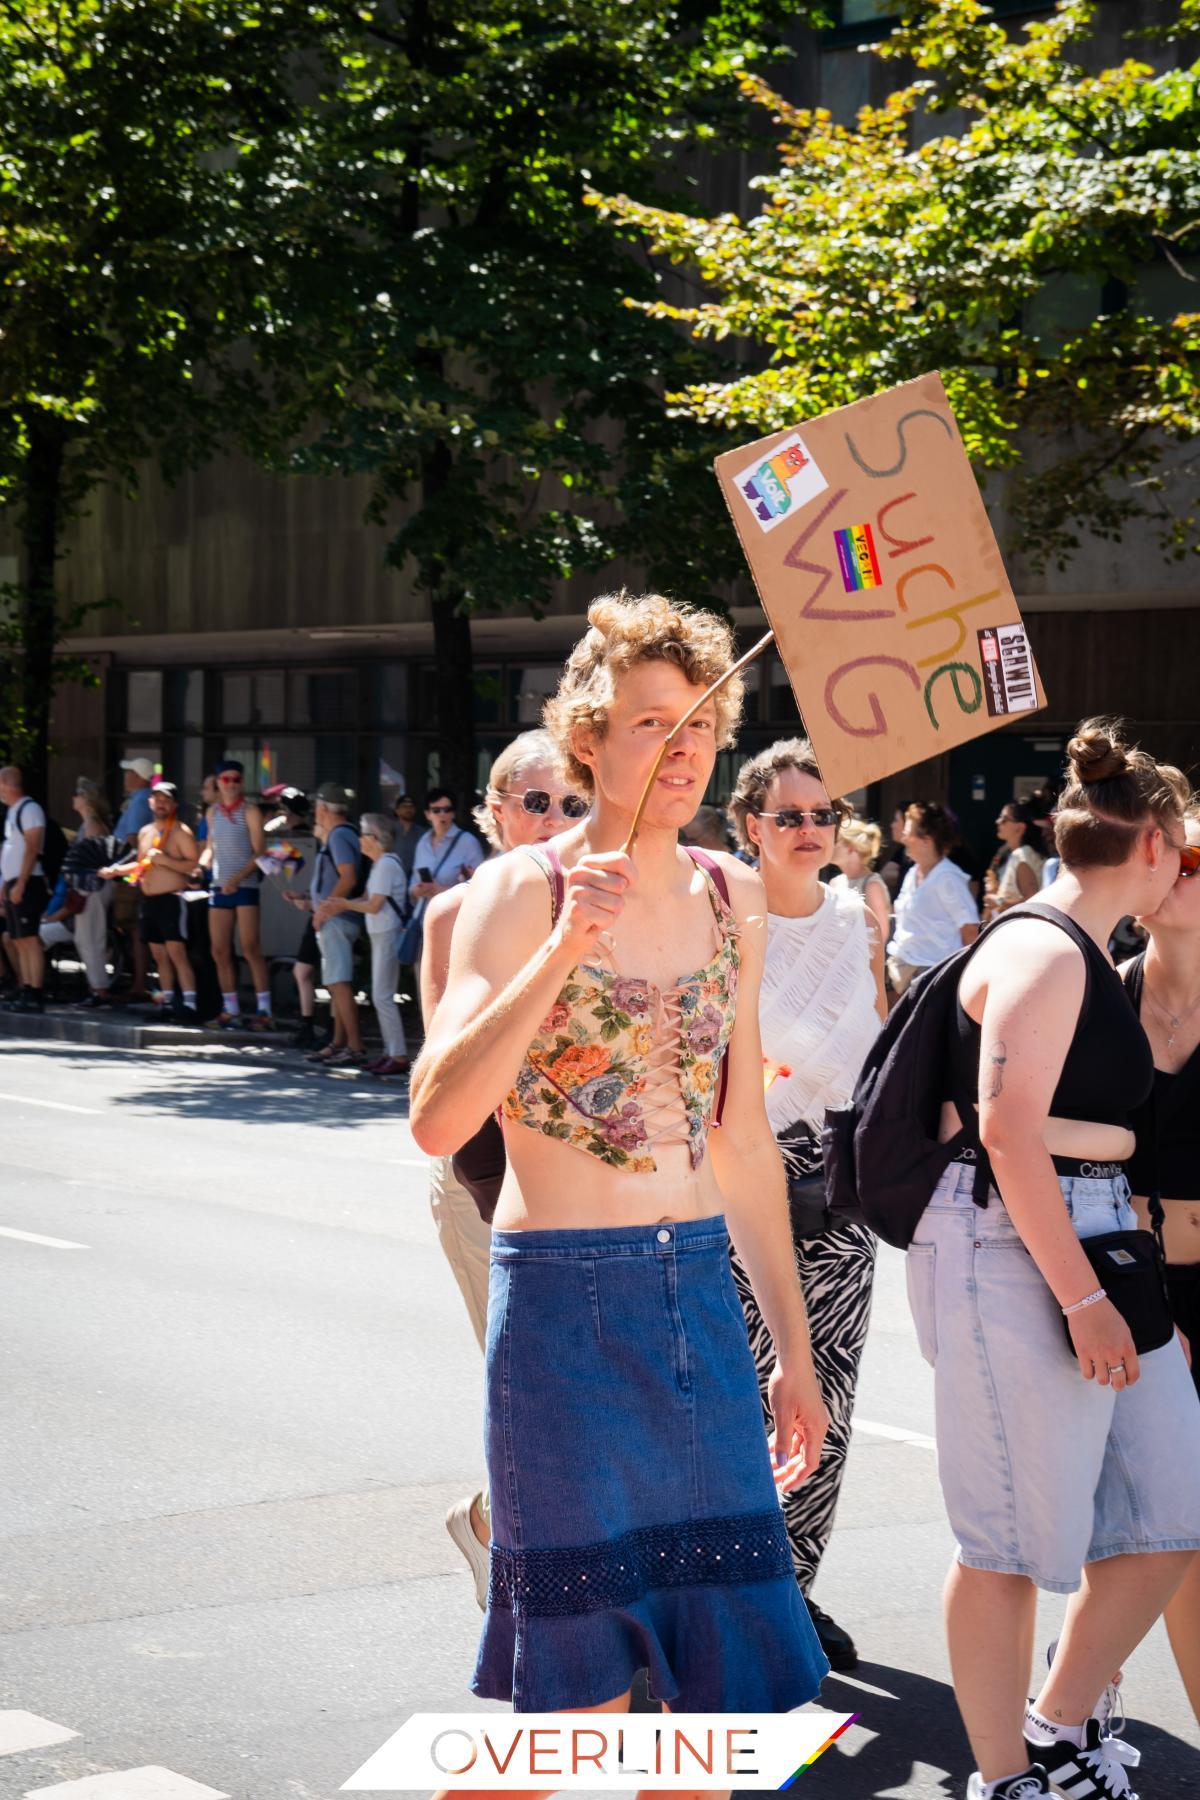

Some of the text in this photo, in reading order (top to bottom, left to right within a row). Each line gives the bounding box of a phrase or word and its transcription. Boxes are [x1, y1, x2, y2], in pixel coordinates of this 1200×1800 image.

[760, 468, 786, 504] Volt
[783, 488, 921, 738] WG
[844, 408, 1002, 732] Suche
[1001, 635, 1033, 702] SCHWUL
